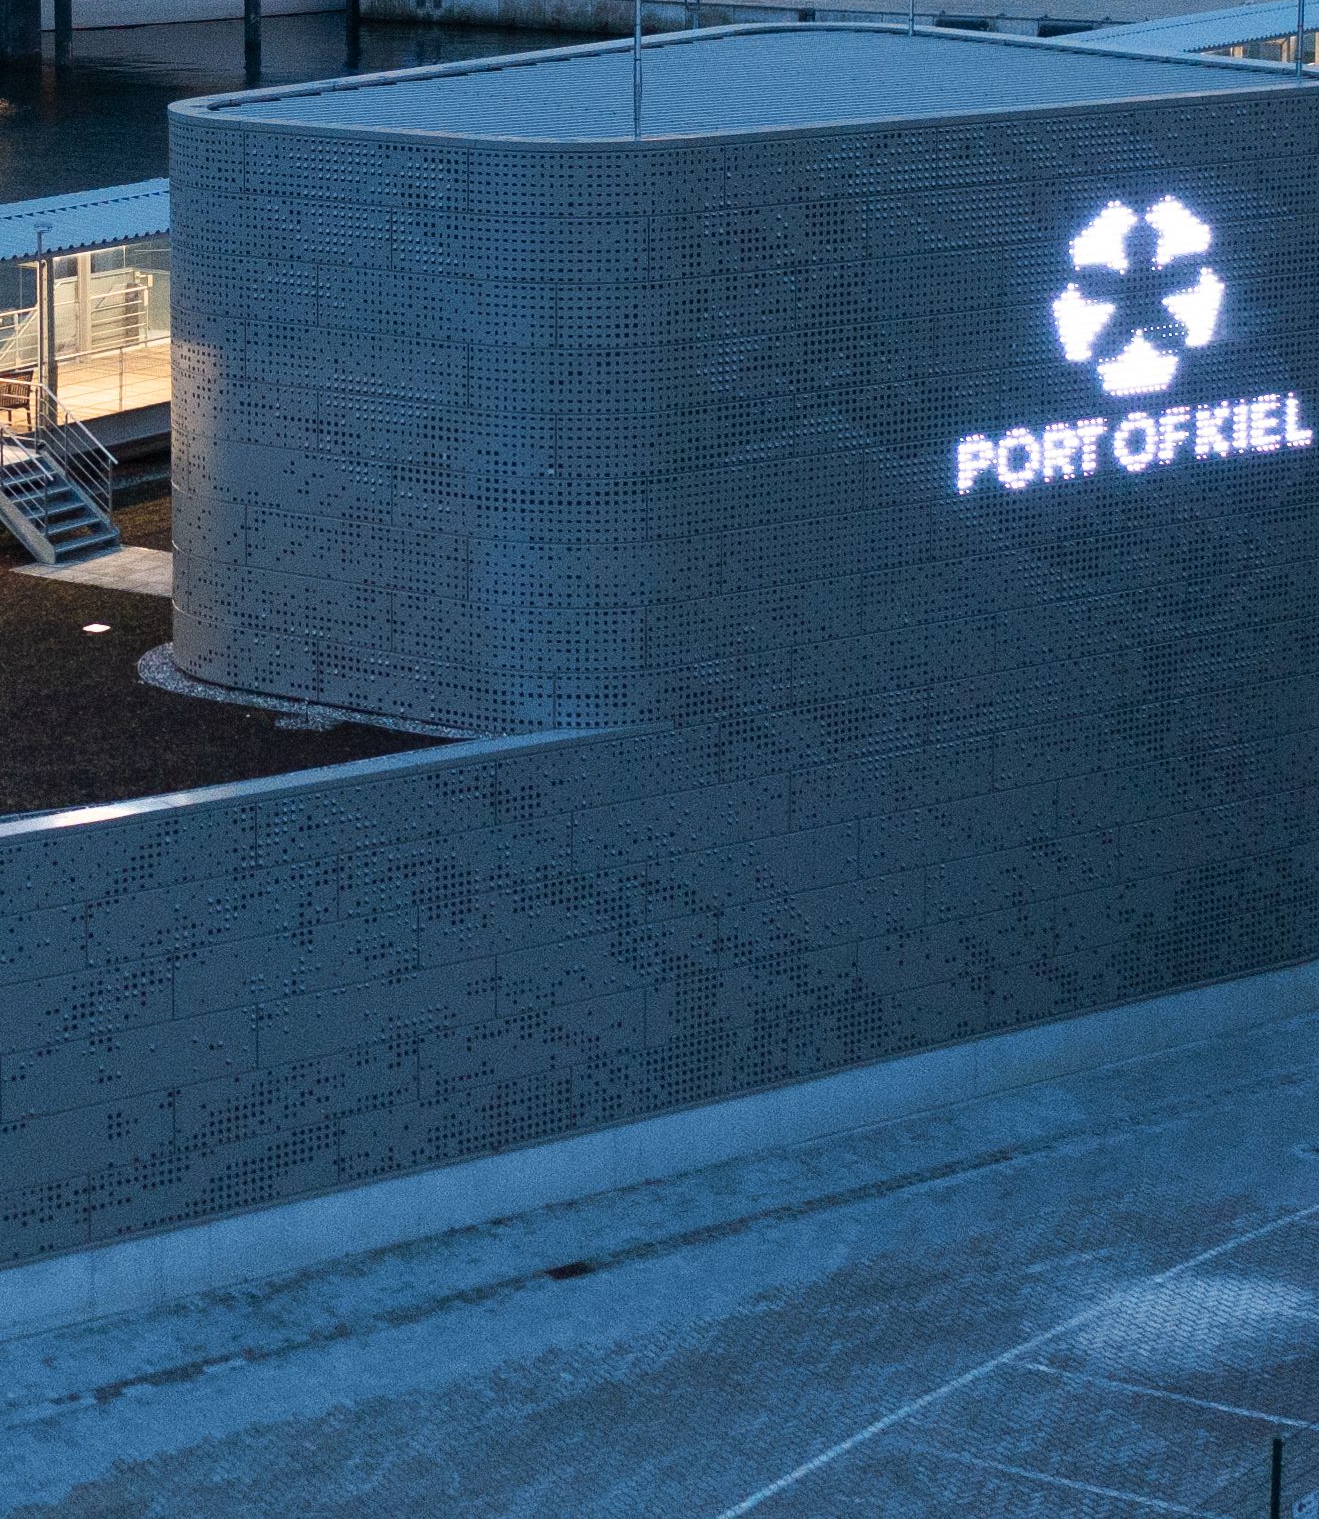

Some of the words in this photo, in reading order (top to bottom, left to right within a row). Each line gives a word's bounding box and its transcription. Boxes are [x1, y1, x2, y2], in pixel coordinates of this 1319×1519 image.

[957, 417, 1108, 495] PORT
[1113, 405, 1191, 472] OF
[1194, 391, 1312, 460] KIEL
